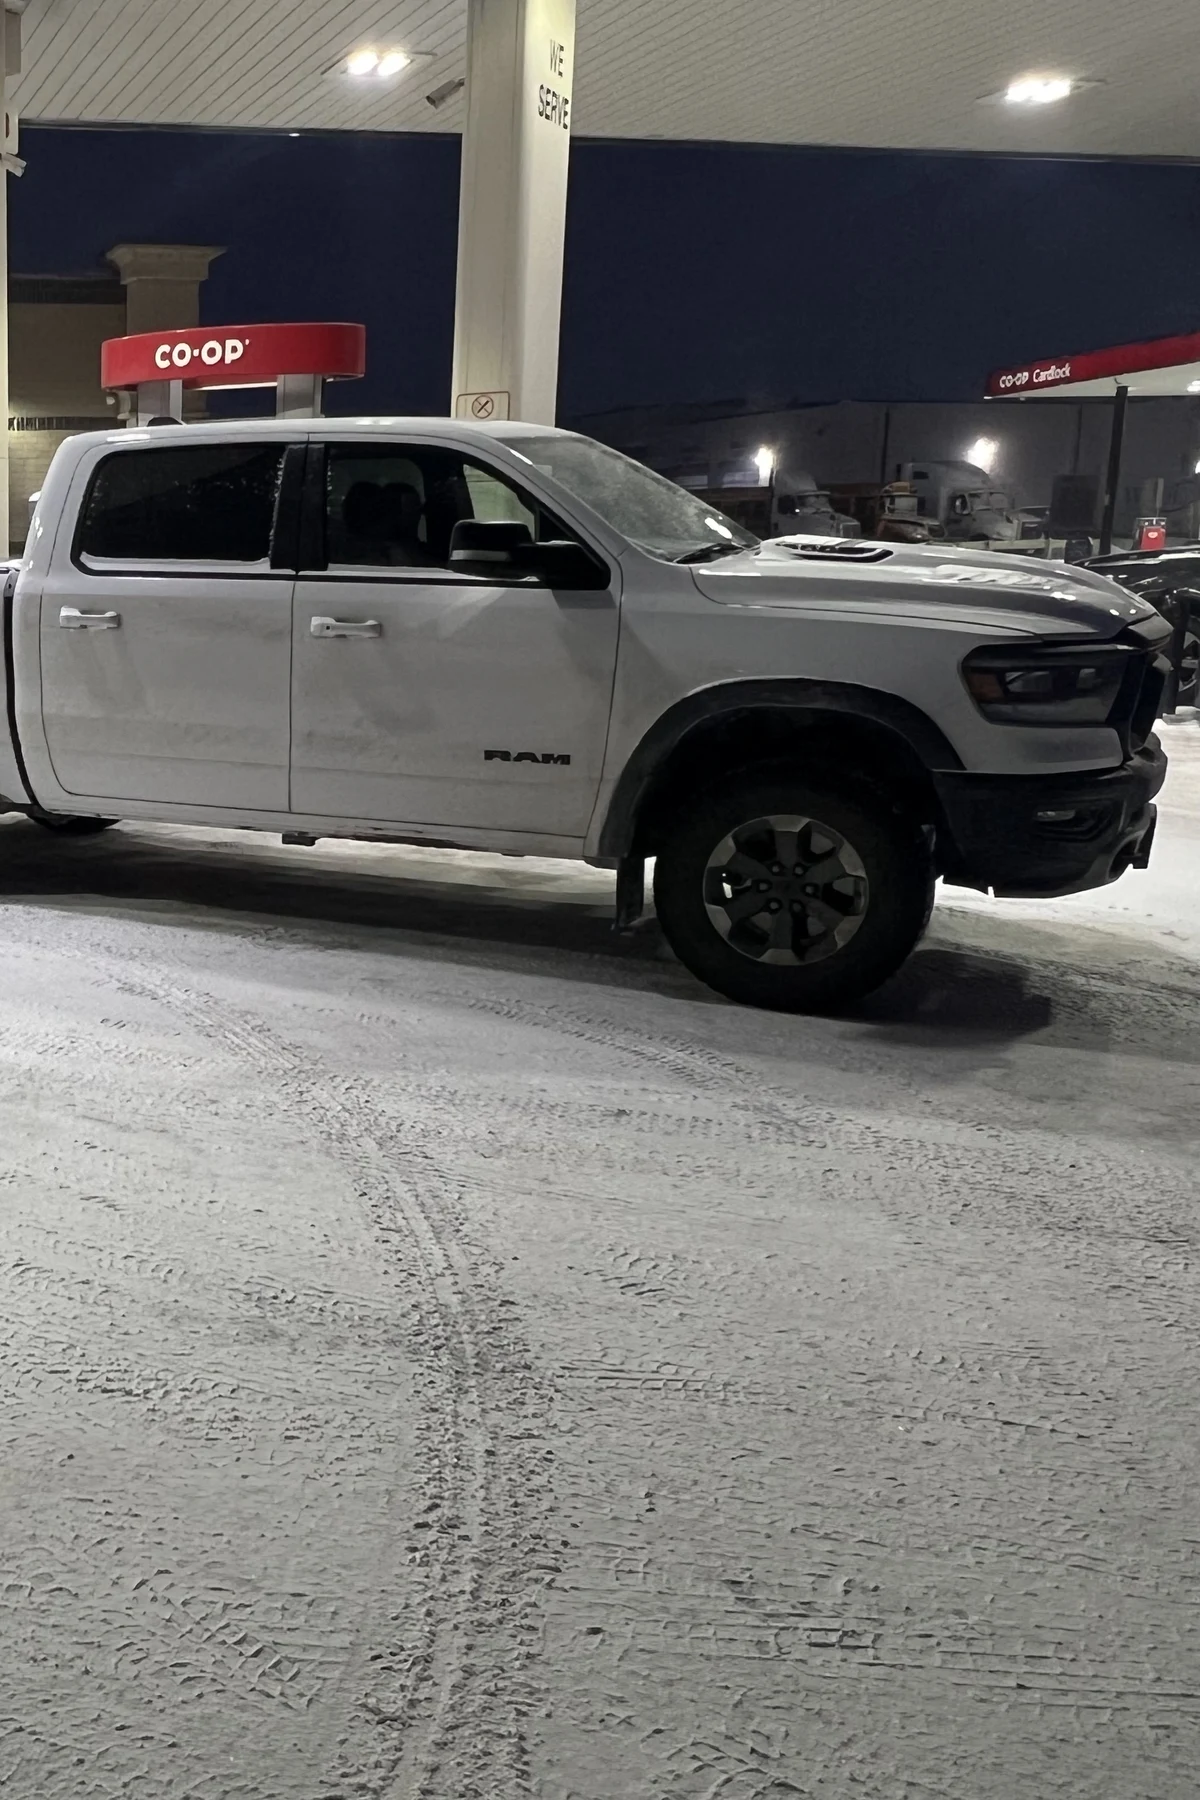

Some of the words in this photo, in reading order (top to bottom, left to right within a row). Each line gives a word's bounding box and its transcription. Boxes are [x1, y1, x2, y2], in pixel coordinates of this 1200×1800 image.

[549, 38, 565, 78] WE
[538, 83, 569, 130] SERVE
[1032, 362, 1072, 384] Cardlock
[483, 749, 571, 766] RAM
